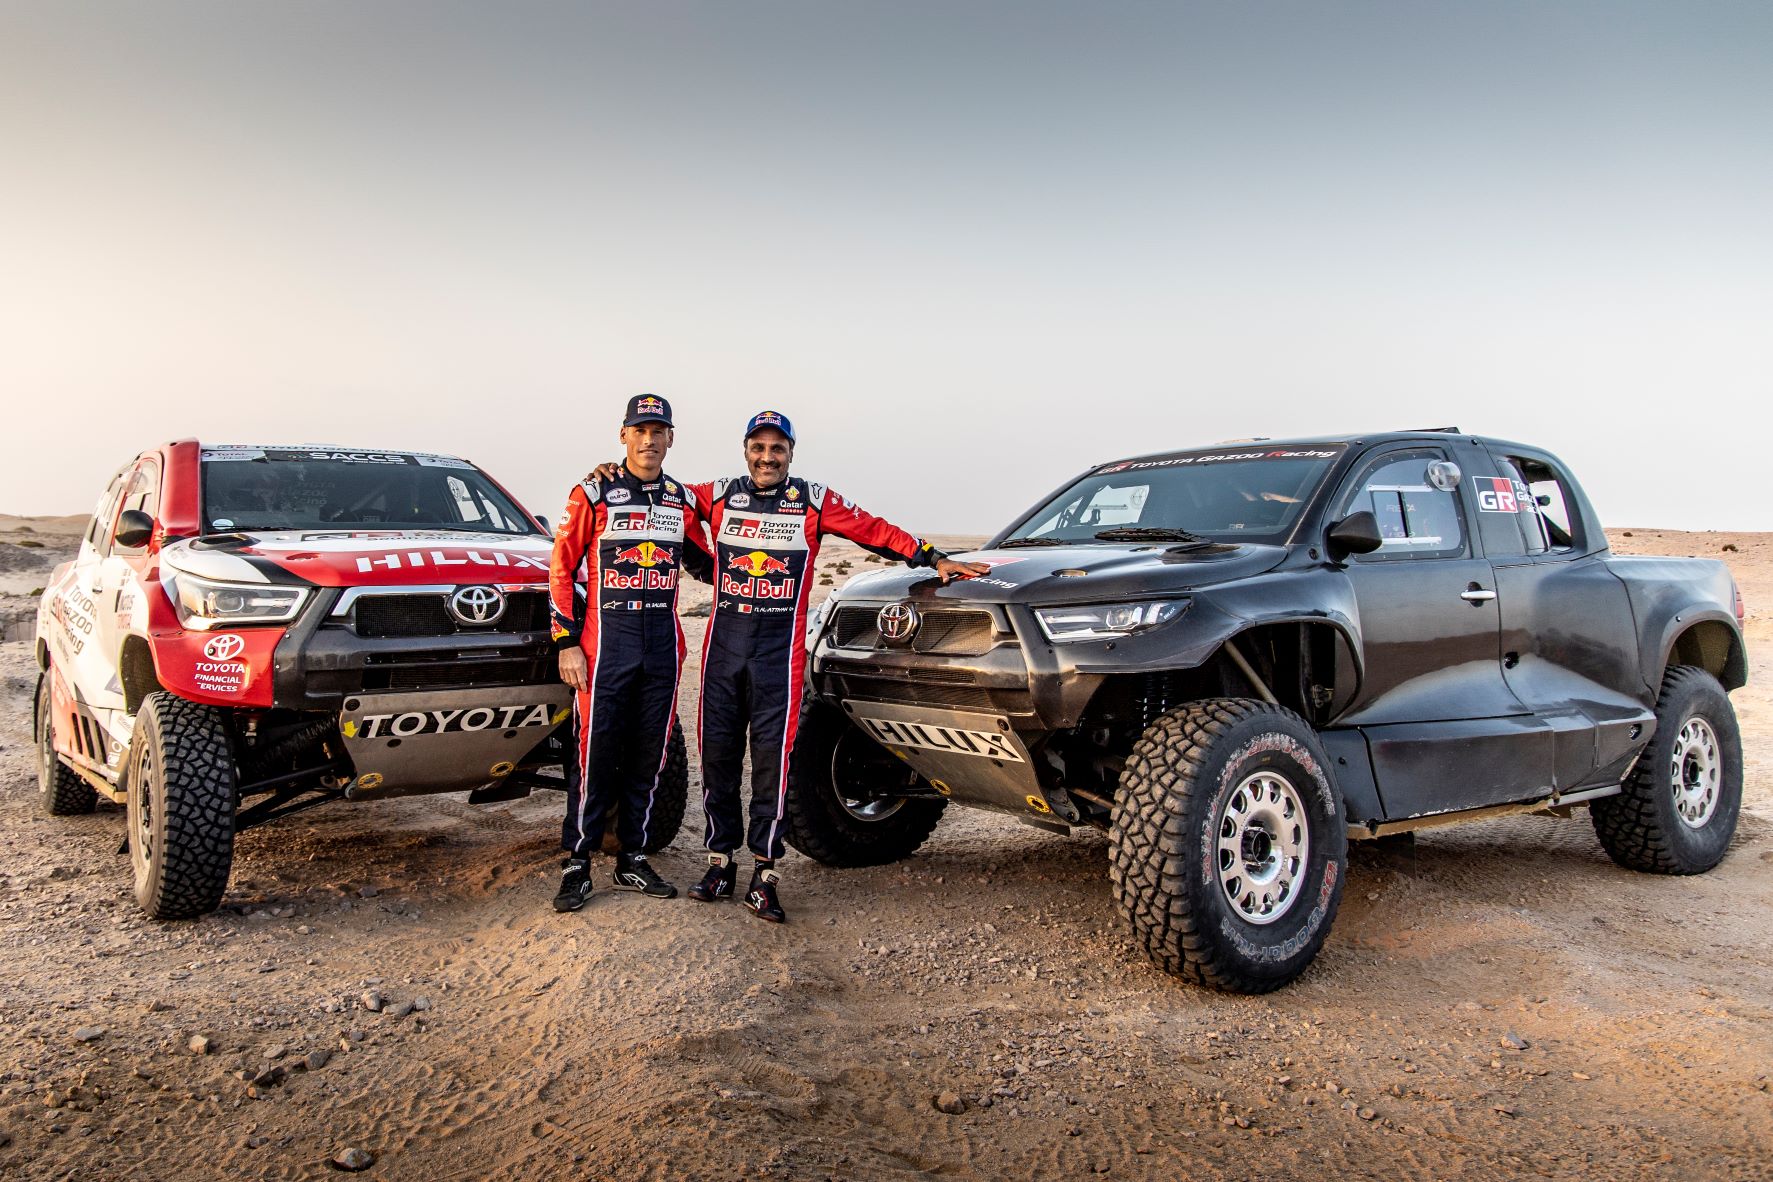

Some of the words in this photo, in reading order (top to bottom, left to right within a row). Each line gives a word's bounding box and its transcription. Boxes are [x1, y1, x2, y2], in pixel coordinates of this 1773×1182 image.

[309, 452, 405, 462] SACCS
[1129, 458, 1192, 470] TOYOTA
[1196, 452, 1263, 463] GAZOO
[1265, 450, 1337, 458] Racing
[662, 493, 682, 504] Qatar
[780, 500, 804, 508] Qatar
[1480, 490, 1516, 510] GR
[652, 512, 682, 521] TOYOTA
[612, 519, 645, 530] GR
[725, 524, 756, 538] GR
[757, 533, 793, 542] Racing
[355, 551, 550, 573] HILUX
[604, 568, 644, 589] Red
[648, 568, 678, 590] Bull
[721, 573, 755, 598] Red
[756, 579, 795, 599] Bull
[195, 662, 245, 673] TOYOTA
[194, 673, 241, 684] FINANCIAL
[362, 704, 550, 738] TOYOTA
[865, 719, 1020, 759] HILUX
